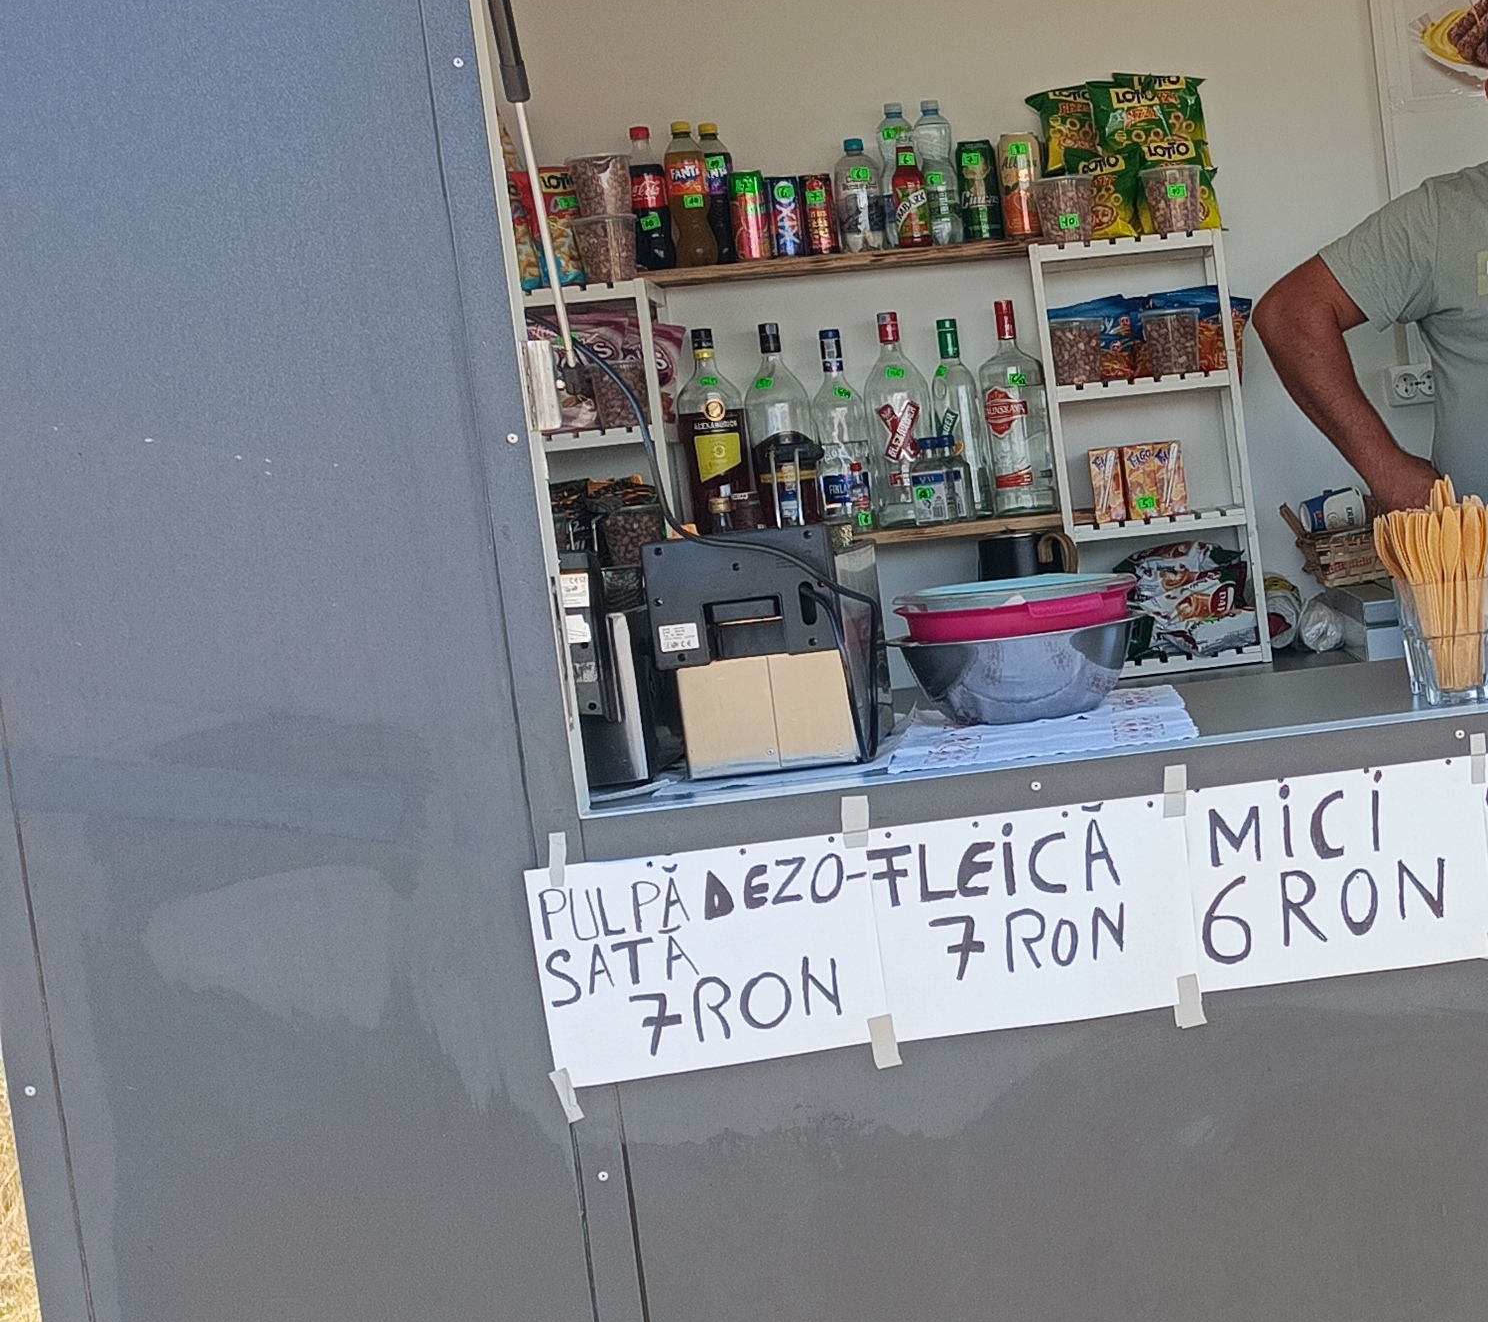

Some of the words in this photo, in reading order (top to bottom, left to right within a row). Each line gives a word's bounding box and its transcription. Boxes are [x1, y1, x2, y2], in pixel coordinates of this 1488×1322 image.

[1147, 142, 1190, 160] LOTTO
[867, 800, 1122, 908] FLEICĂ
[1208, 770, 1383, 868] MICI
[538, 863, 690, 943] PULPĂ
[703, 852, 867, 921] DEZO-
[1202, 875, 1253, 965] 6
[1280, 857, 1446, 948] RON
[545, 927, 699, 1008] SATĂ
